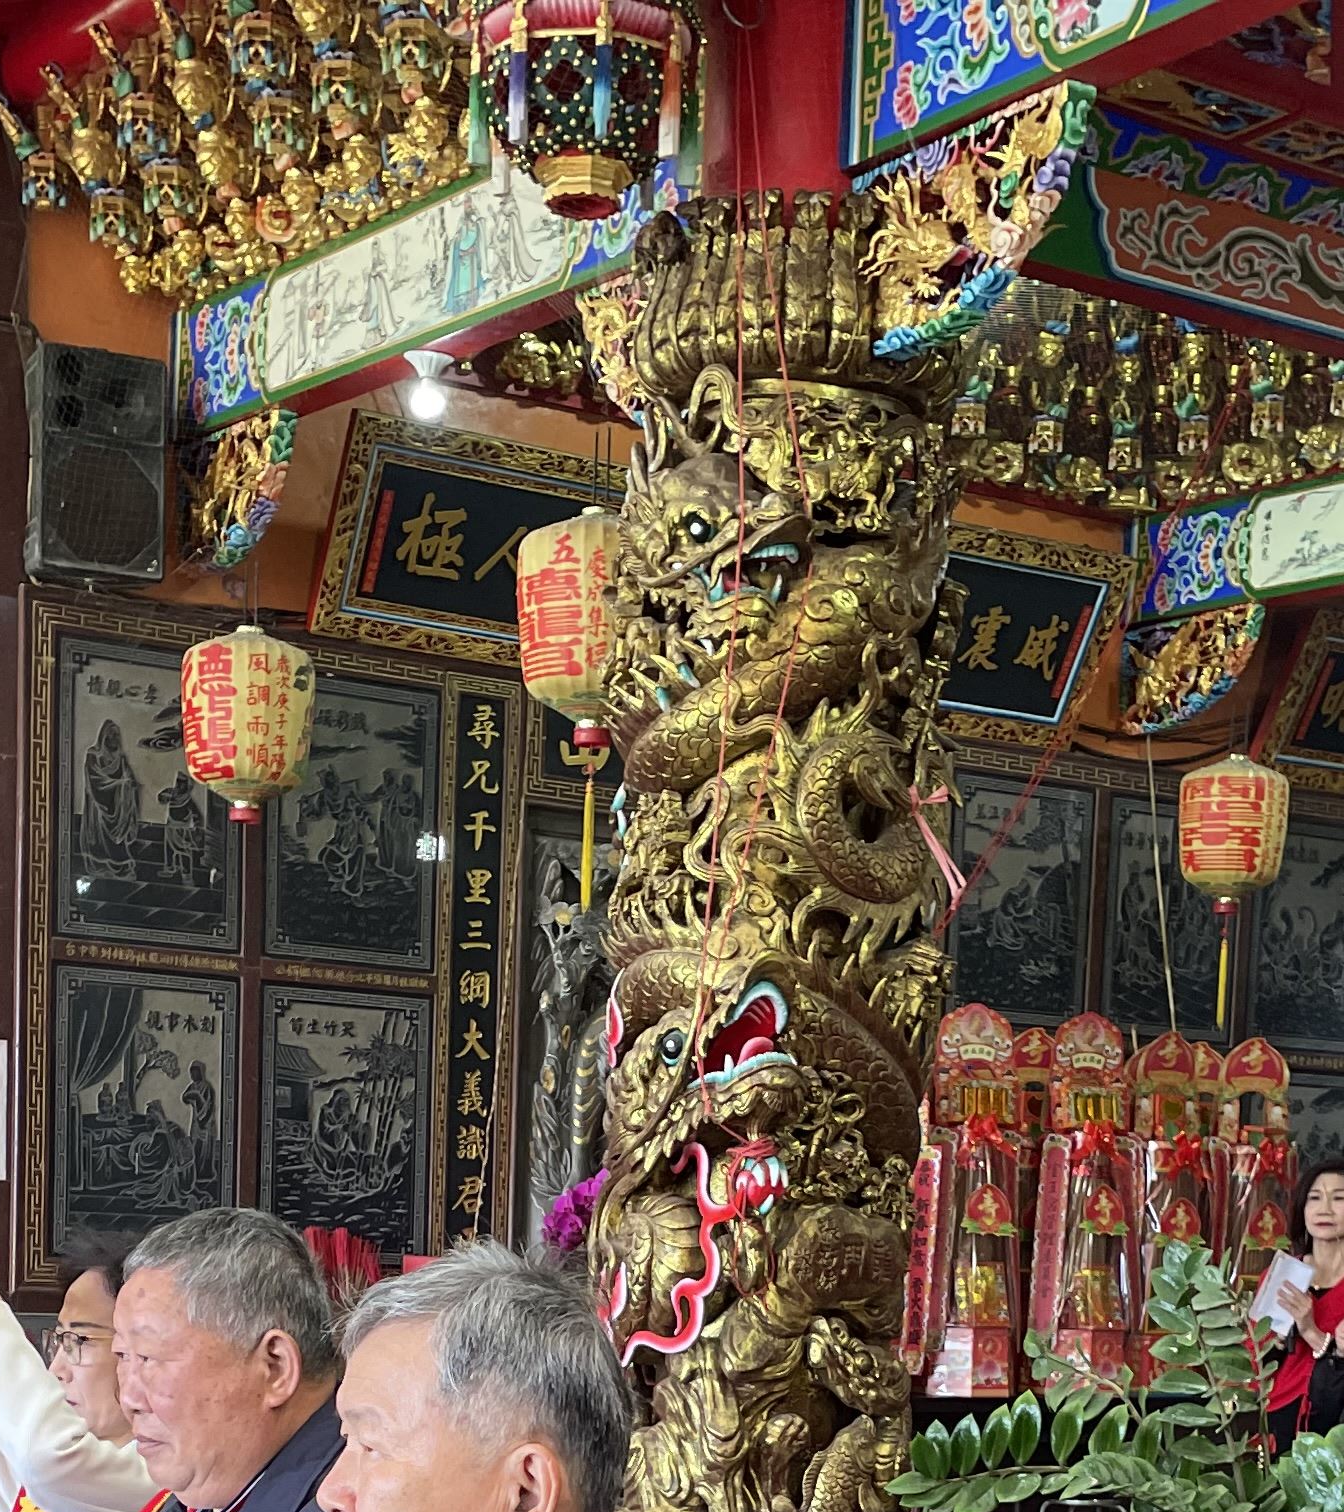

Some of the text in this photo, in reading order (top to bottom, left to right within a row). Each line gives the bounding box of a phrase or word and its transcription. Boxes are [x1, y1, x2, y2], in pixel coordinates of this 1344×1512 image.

[956, 605, 1070, 681] 威震
[246, 653, 272, 769] 風調雨順
[452, 705, 501, 1246] 尋兄千里三綱大義識君
